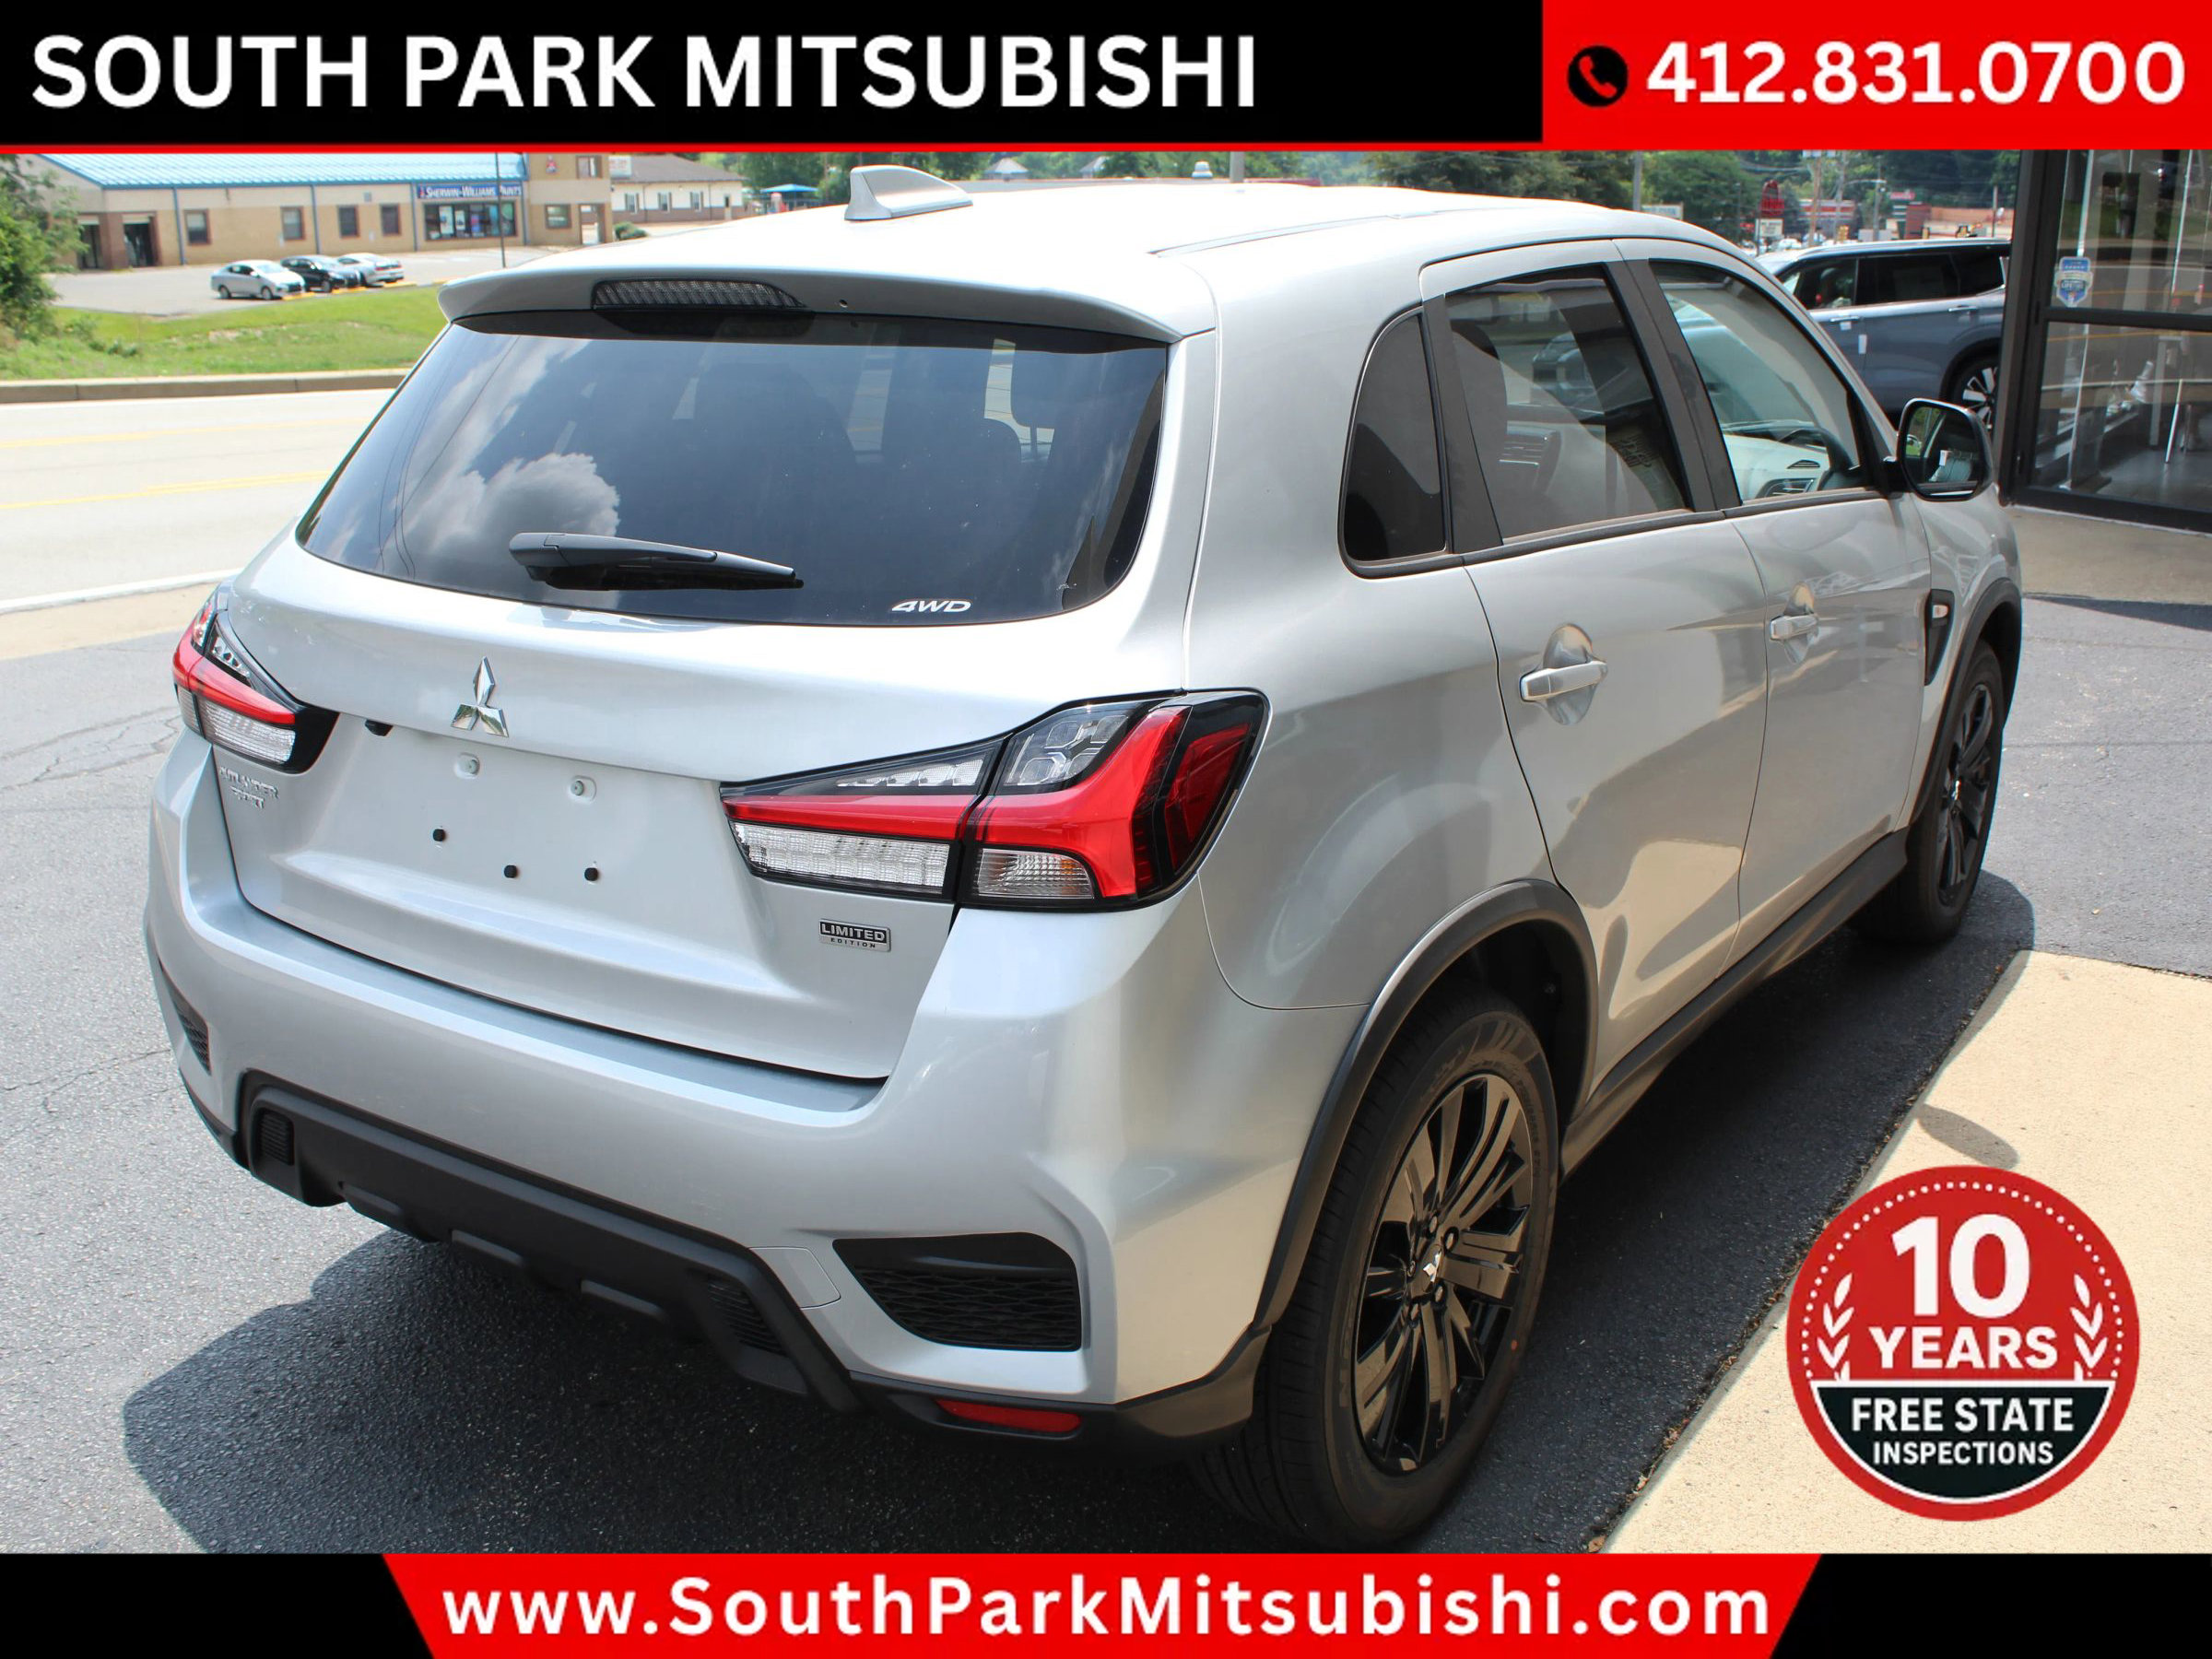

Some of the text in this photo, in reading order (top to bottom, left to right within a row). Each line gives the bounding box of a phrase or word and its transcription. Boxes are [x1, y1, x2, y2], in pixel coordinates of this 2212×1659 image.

[426, 185, 496, 198] SHERWIN-WILLIAMS
[891, 600, 971, 613] 4WD
[821, 924, 885, 941] LIMITED
[830, 937, 876, 948] EDITION
